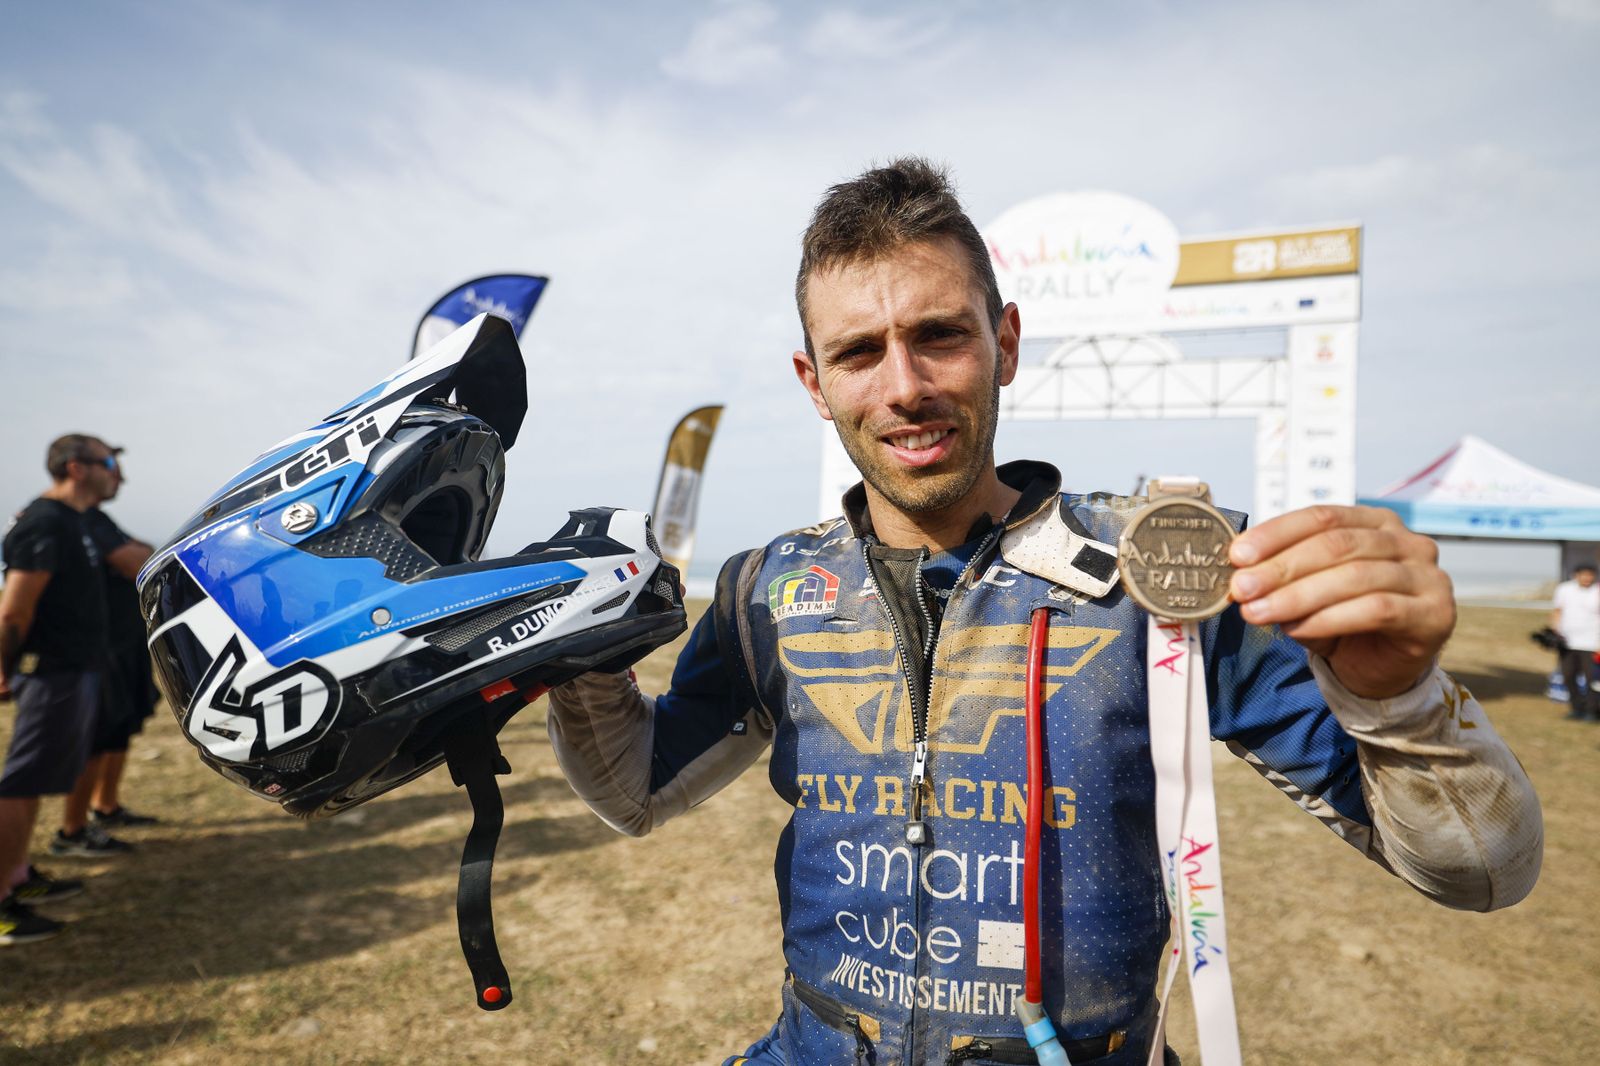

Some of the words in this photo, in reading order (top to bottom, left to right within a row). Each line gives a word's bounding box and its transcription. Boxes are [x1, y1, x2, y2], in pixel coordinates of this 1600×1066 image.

[1016, 271, 1124, 301] RALLY
[357, 607, 442, 640] Advanced
[443, 591, 499, 613] Impact
[501, 574, 562, 595] Defense
[1150, 568, 1219, 590] RALLY
[486, 635, 512, 655] R.
[796, 773, 863, 813] FLY
[874, 774, 1077, 830] RACING
[835, 839, 1025, 906] smart
[834, 906, 962, 965] cube
[1181, 836, 1223, 978] Andalucía
